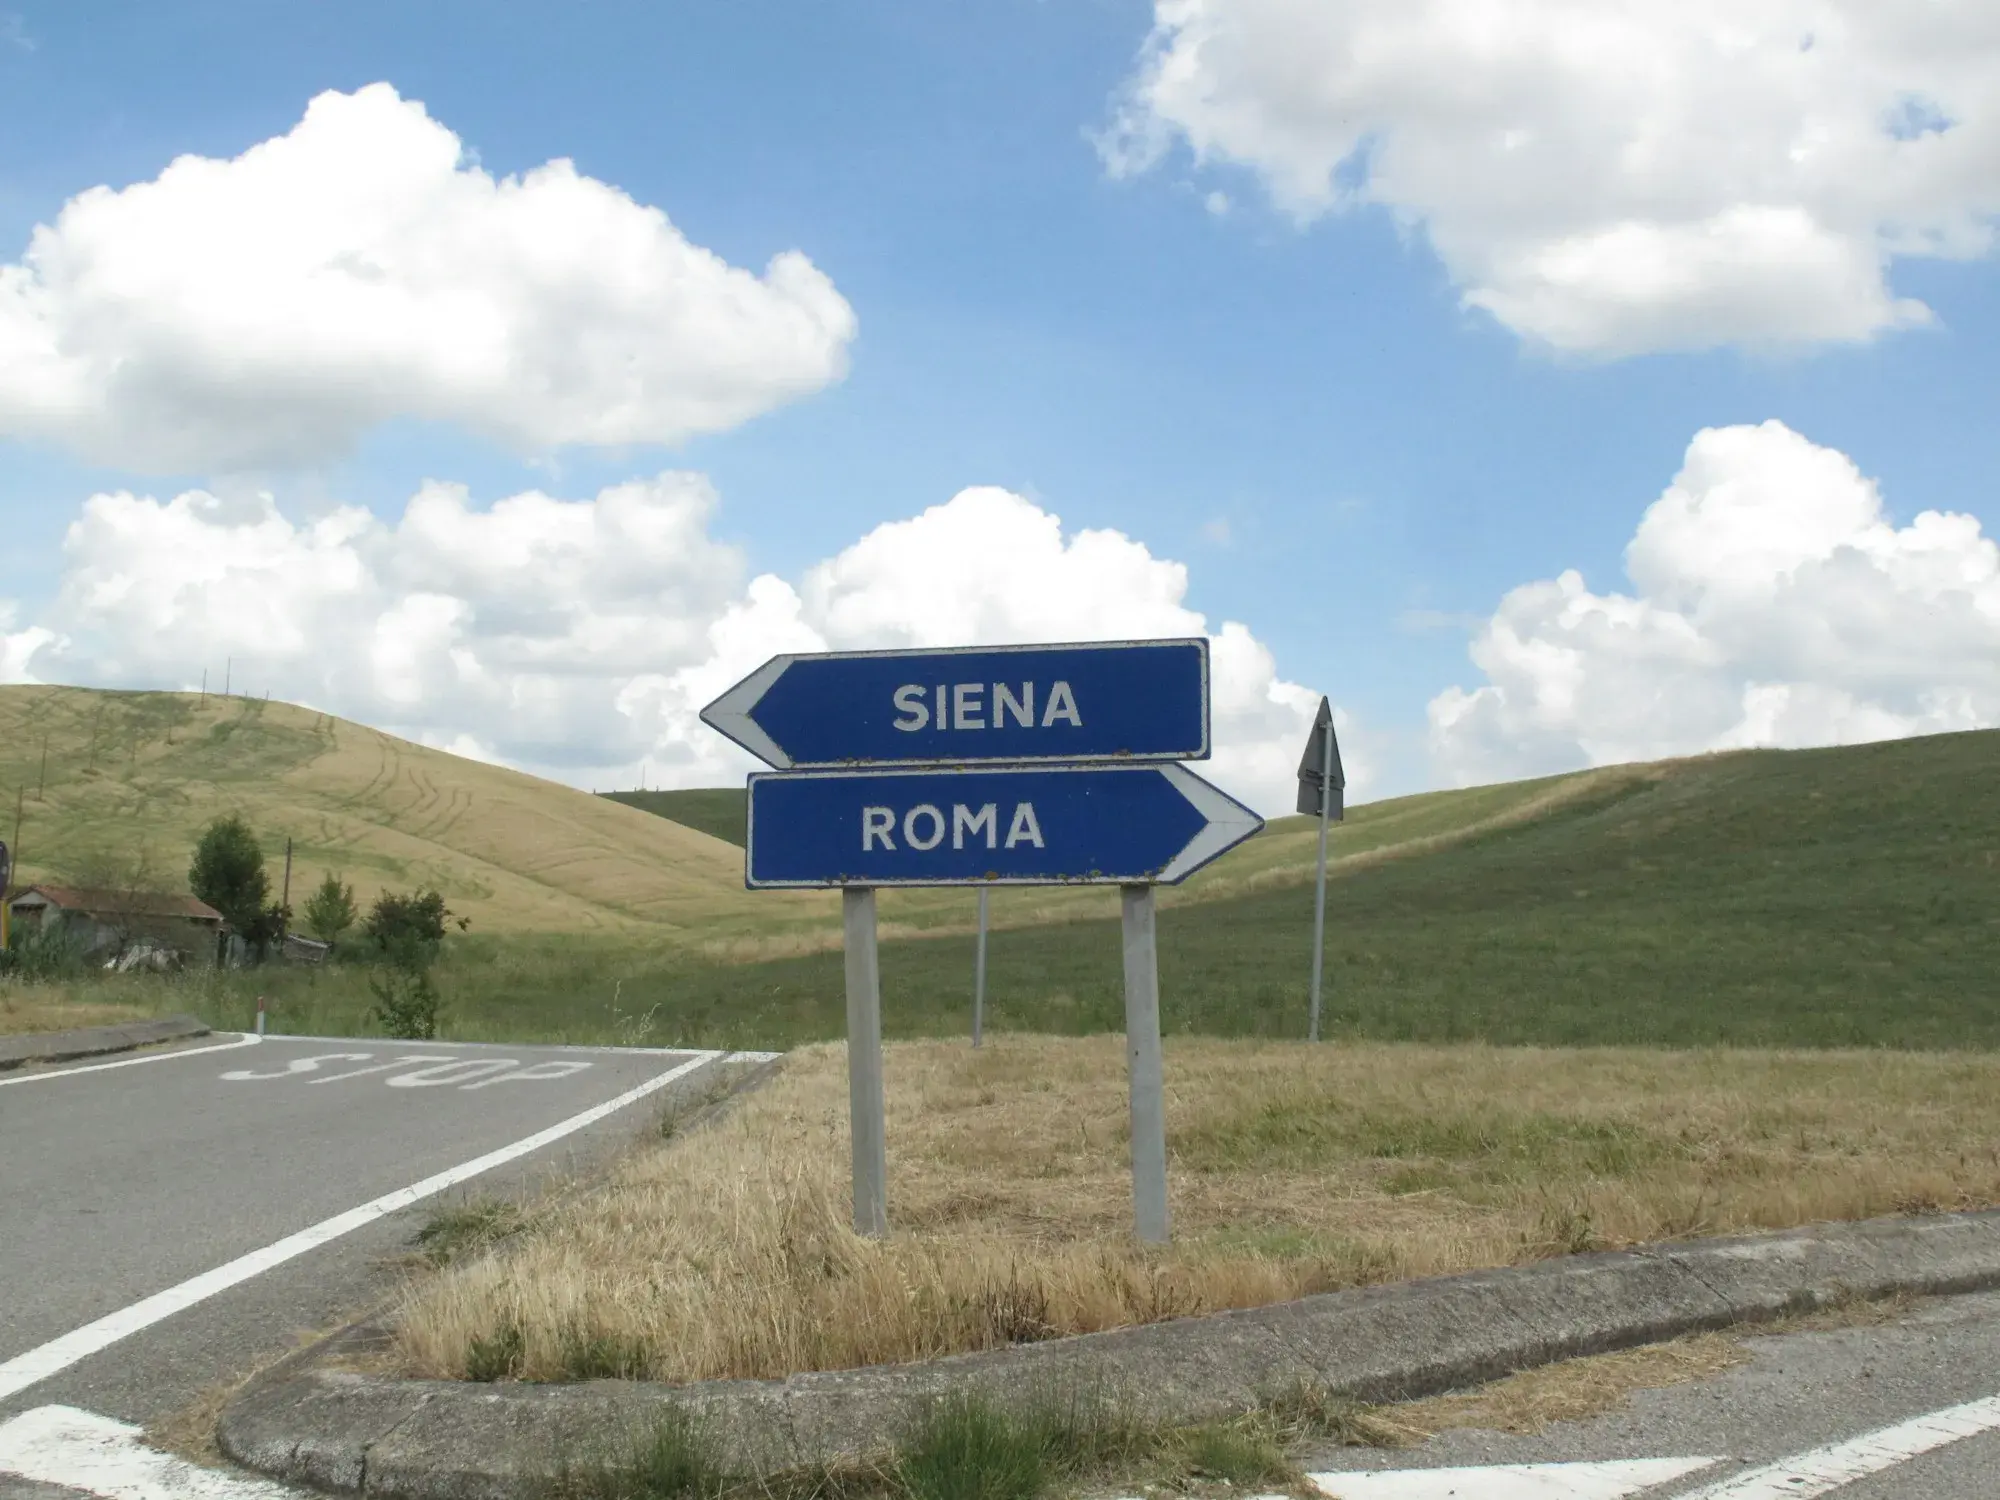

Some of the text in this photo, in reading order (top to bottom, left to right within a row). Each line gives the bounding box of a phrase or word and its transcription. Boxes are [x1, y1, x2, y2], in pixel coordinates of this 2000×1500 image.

[892, 680, 1083, 732] SIENA
[862, 802, 1045, 851] ROMA
[219, 1053, 594, 1090] STOP
